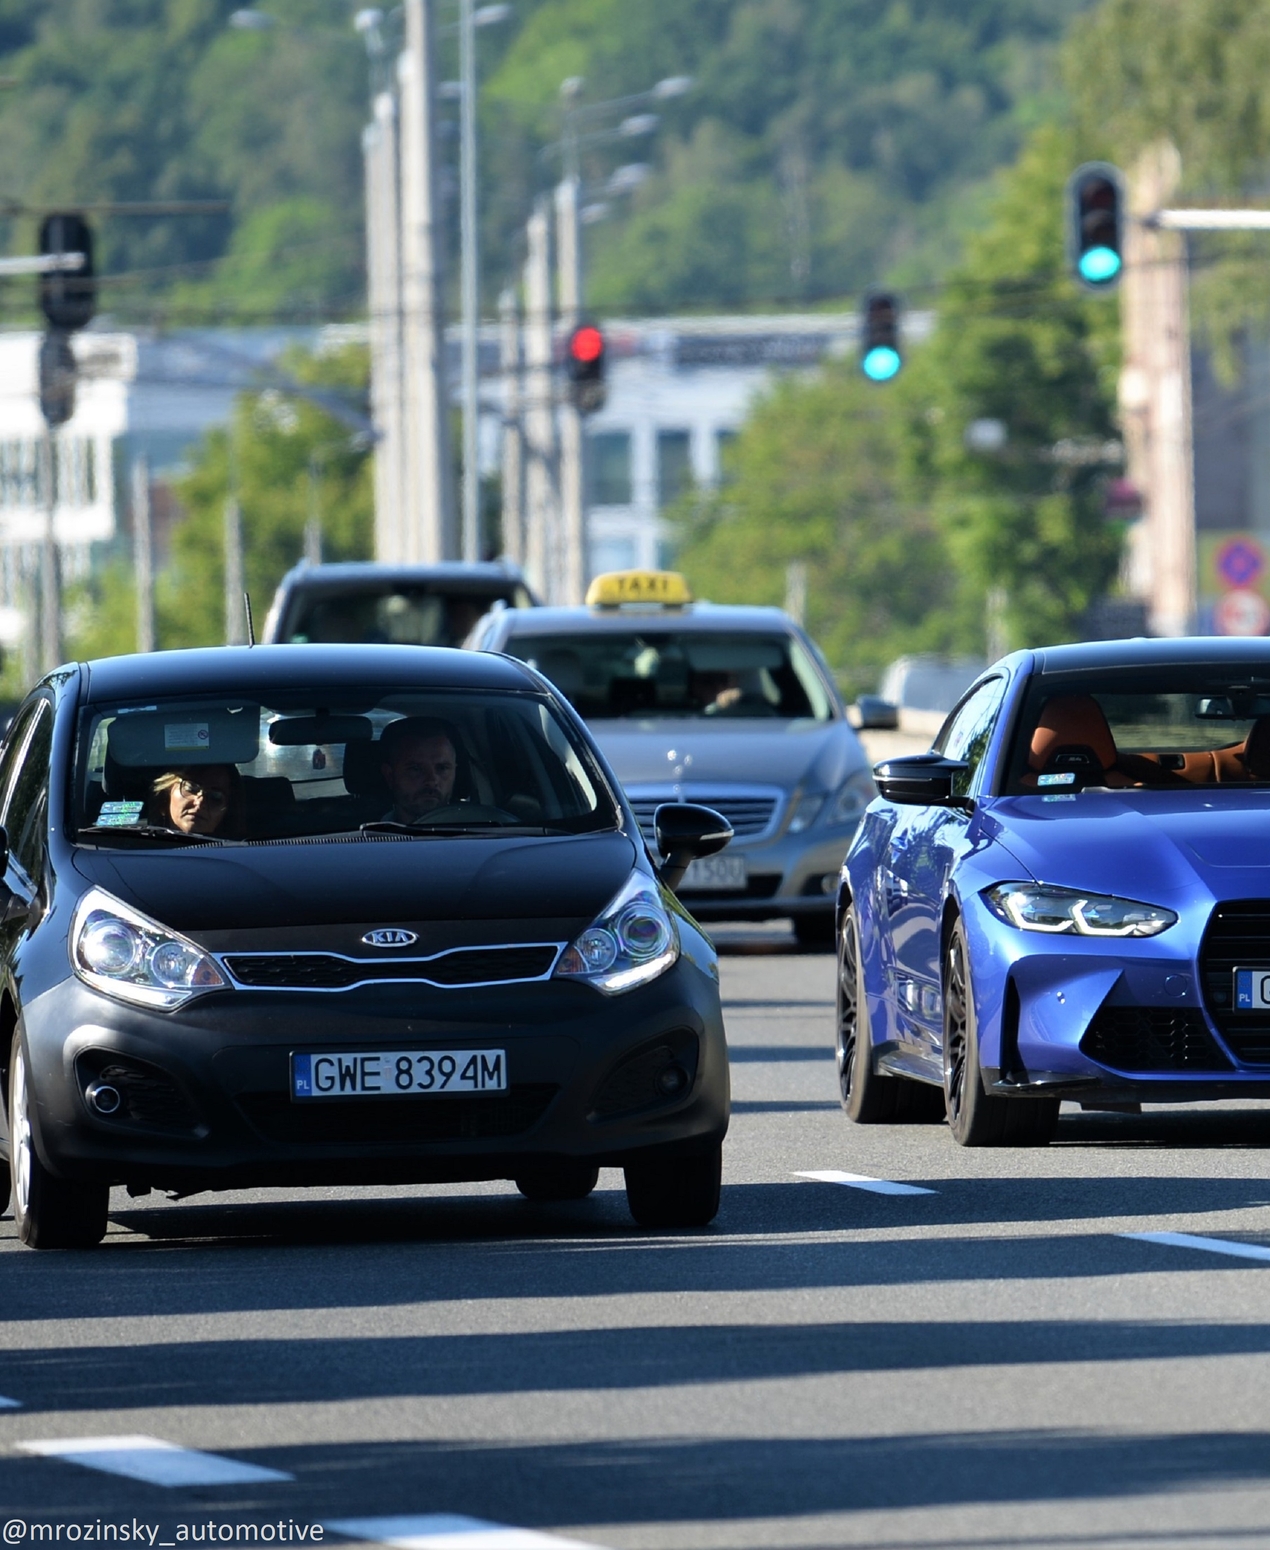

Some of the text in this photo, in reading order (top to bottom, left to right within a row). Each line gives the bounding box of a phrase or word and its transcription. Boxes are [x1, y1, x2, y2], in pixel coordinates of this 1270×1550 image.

[615, 577, 669, 593] TAXI
[371, 932, 409, 943] KIA
[1239, 993, 1250, 1003] PL
[296, 1054, 502, 1092] PL GWE 8394M
